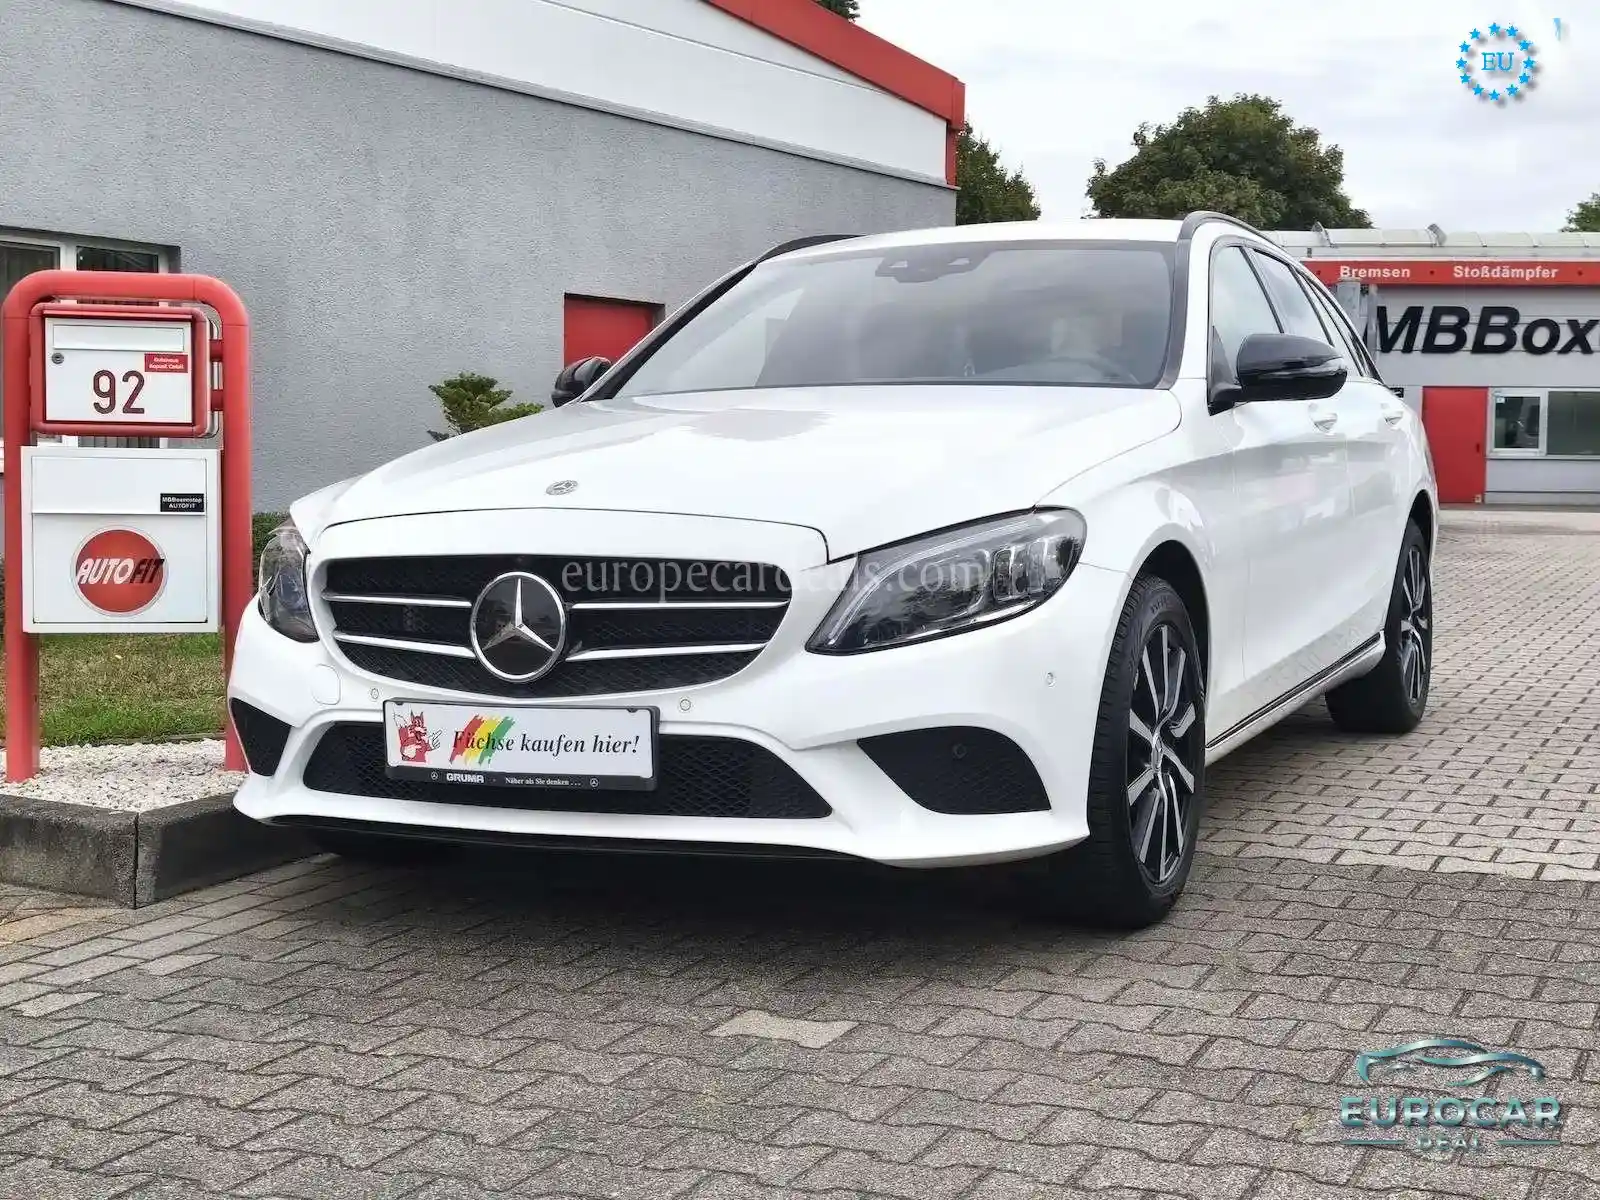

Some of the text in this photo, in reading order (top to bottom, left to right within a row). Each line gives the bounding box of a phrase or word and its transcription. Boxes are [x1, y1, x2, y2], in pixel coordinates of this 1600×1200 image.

[1339, 265, 1559, 281] Bremsen Stoßdämpfer
[1362, 305, 1600, 355] MBBox
[93, 369, 146, 415] 92
[76, 557, 164, 585] AUTOFIT
[452, 730, 641, 757] Füchse kaufen hier!
[446, 772, 485, 784] GRUMA
